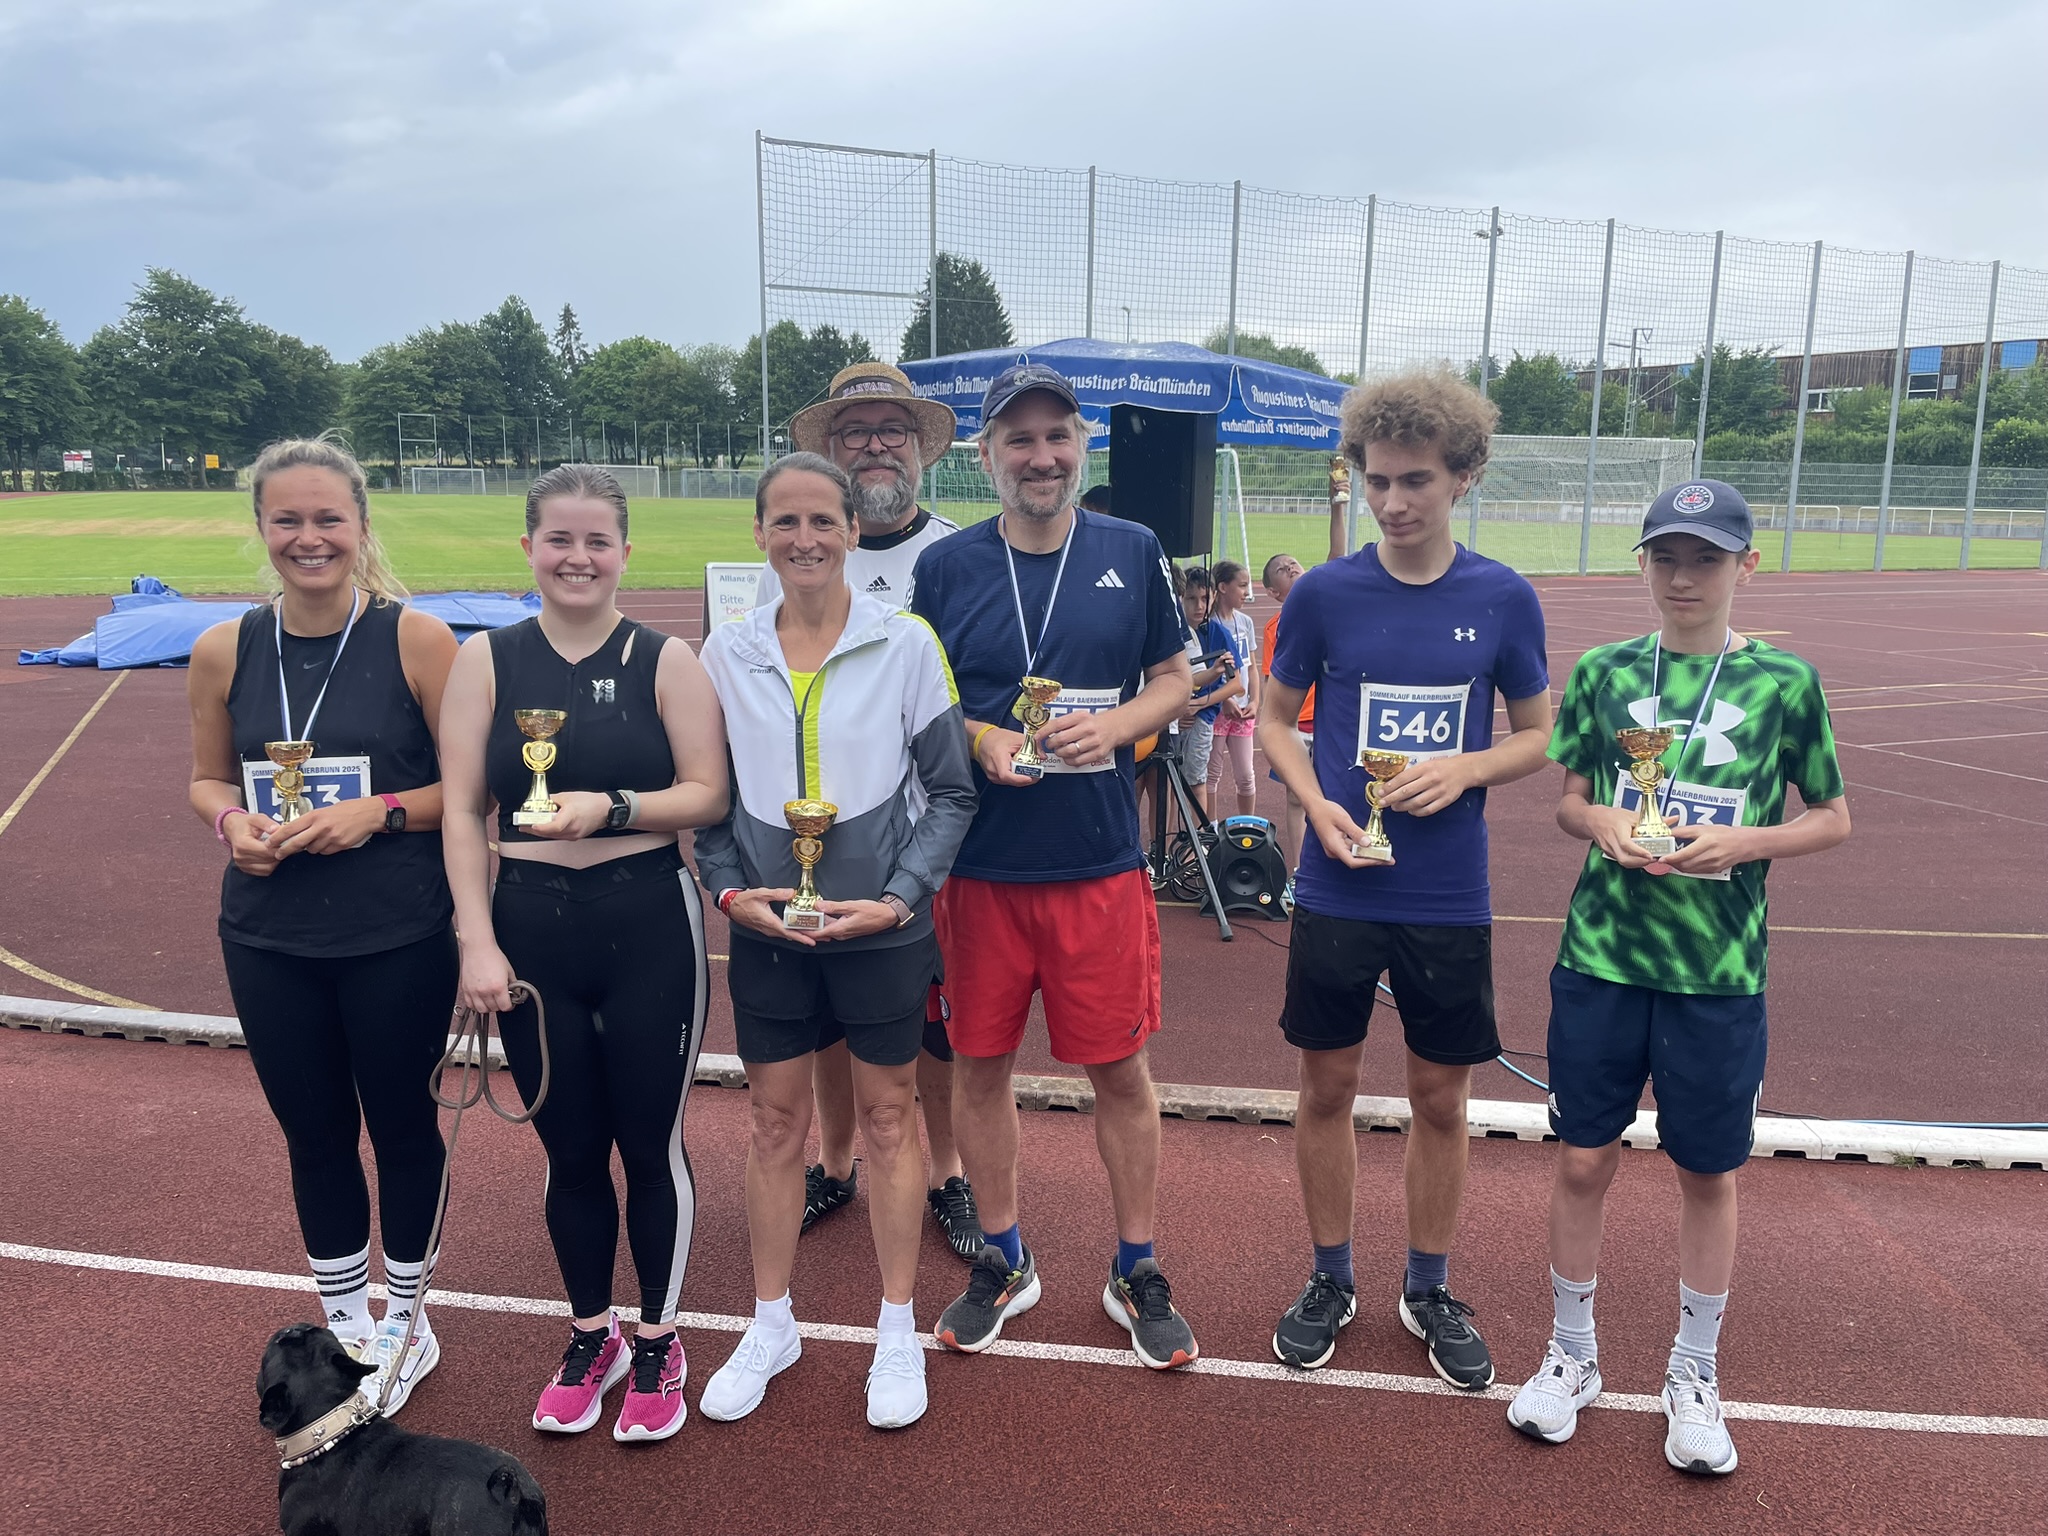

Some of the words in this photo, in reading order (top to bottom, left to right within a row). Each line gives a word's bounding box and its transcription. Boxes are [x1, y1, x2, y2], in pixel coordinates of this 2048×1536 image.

[720, 574, 746, 582] Allianz
[719, 594, 744, 605] Bitte
[1369, 690, 1410, 701] SOMMERLAUF
[1378, 708, 1451, 744] 546
[300, 766, 341, 774] AIERBRUNN
[1671, 789, 1719, 804] BAIERBRUNN
[1720, 796, 1738, 805] 2025
